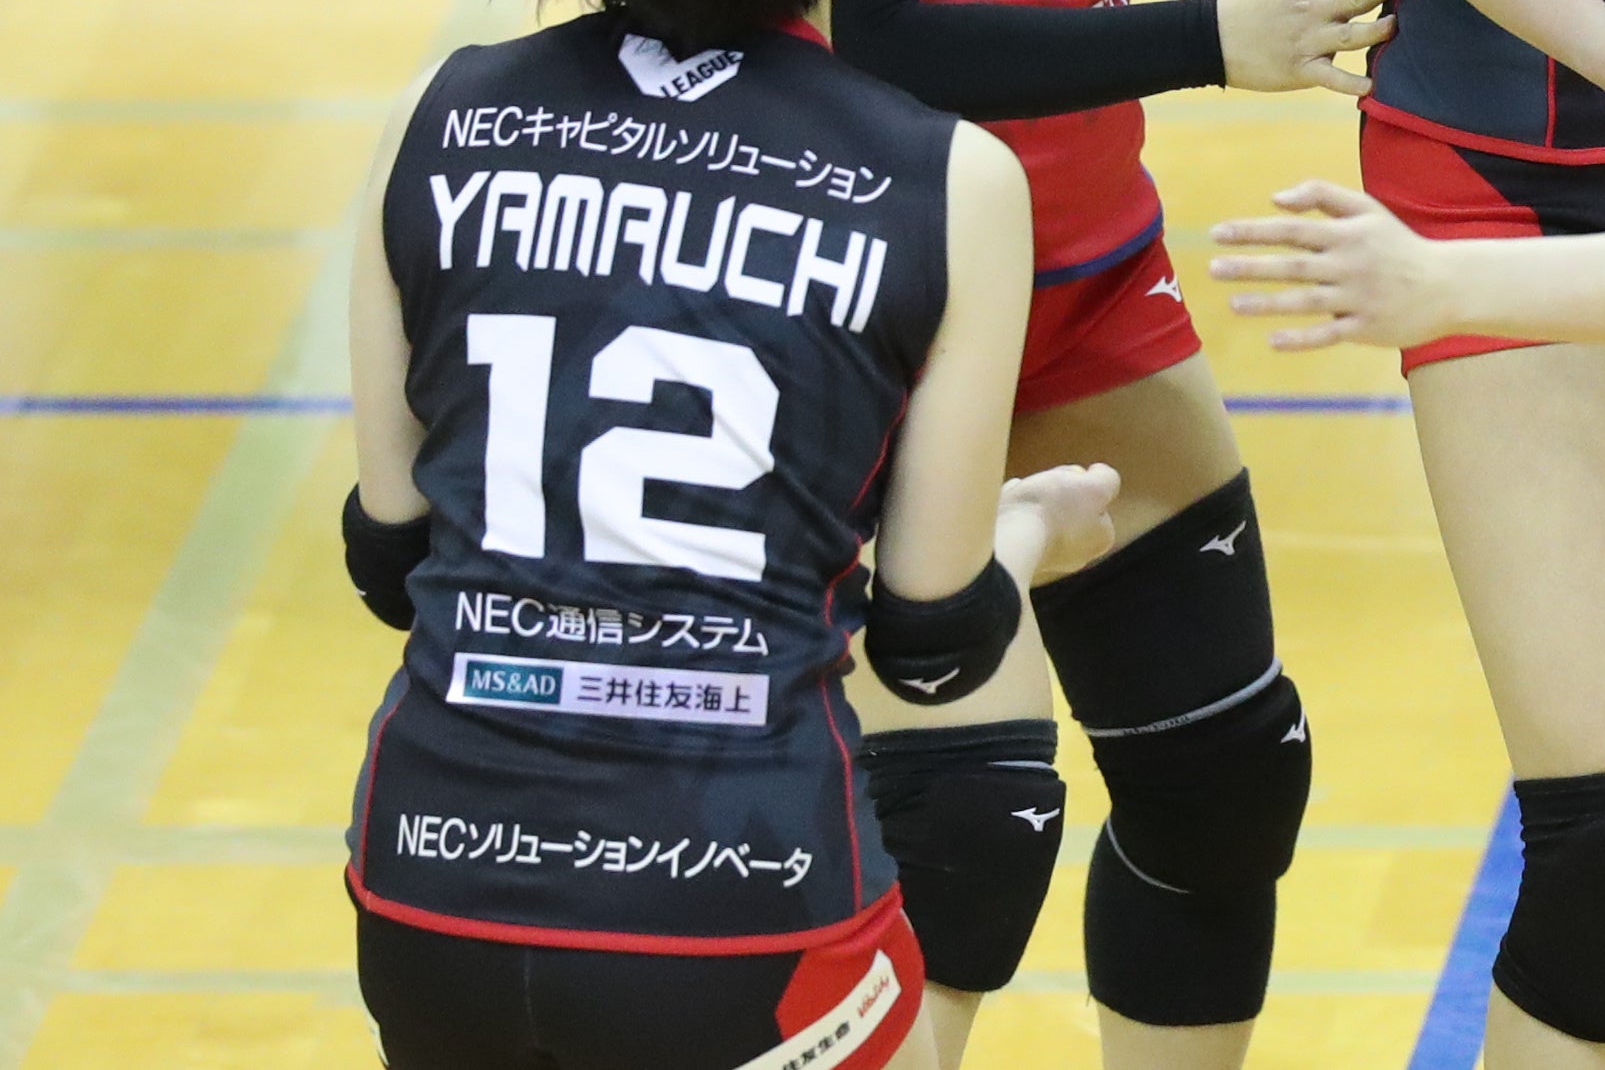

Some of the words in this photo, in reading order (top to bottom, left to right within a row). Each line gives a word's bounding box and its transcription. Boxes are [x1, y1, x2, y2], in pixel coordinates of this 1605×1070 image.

[660, 50, 742, 100] LEAGUE
[442, 106, 892, 203] NECキャピタルソリューション
[429, 169, 888, 334] YAMAUCHI
[467, 313, 780, 582] 12
[455, 591, 769, 657] NEC通信システム
[470, 667, 557, 697] MS&AD
[576, 676, 752, 715] 三井住友海上
[397, 814, 814, 886] NECソリューションイノベータ
